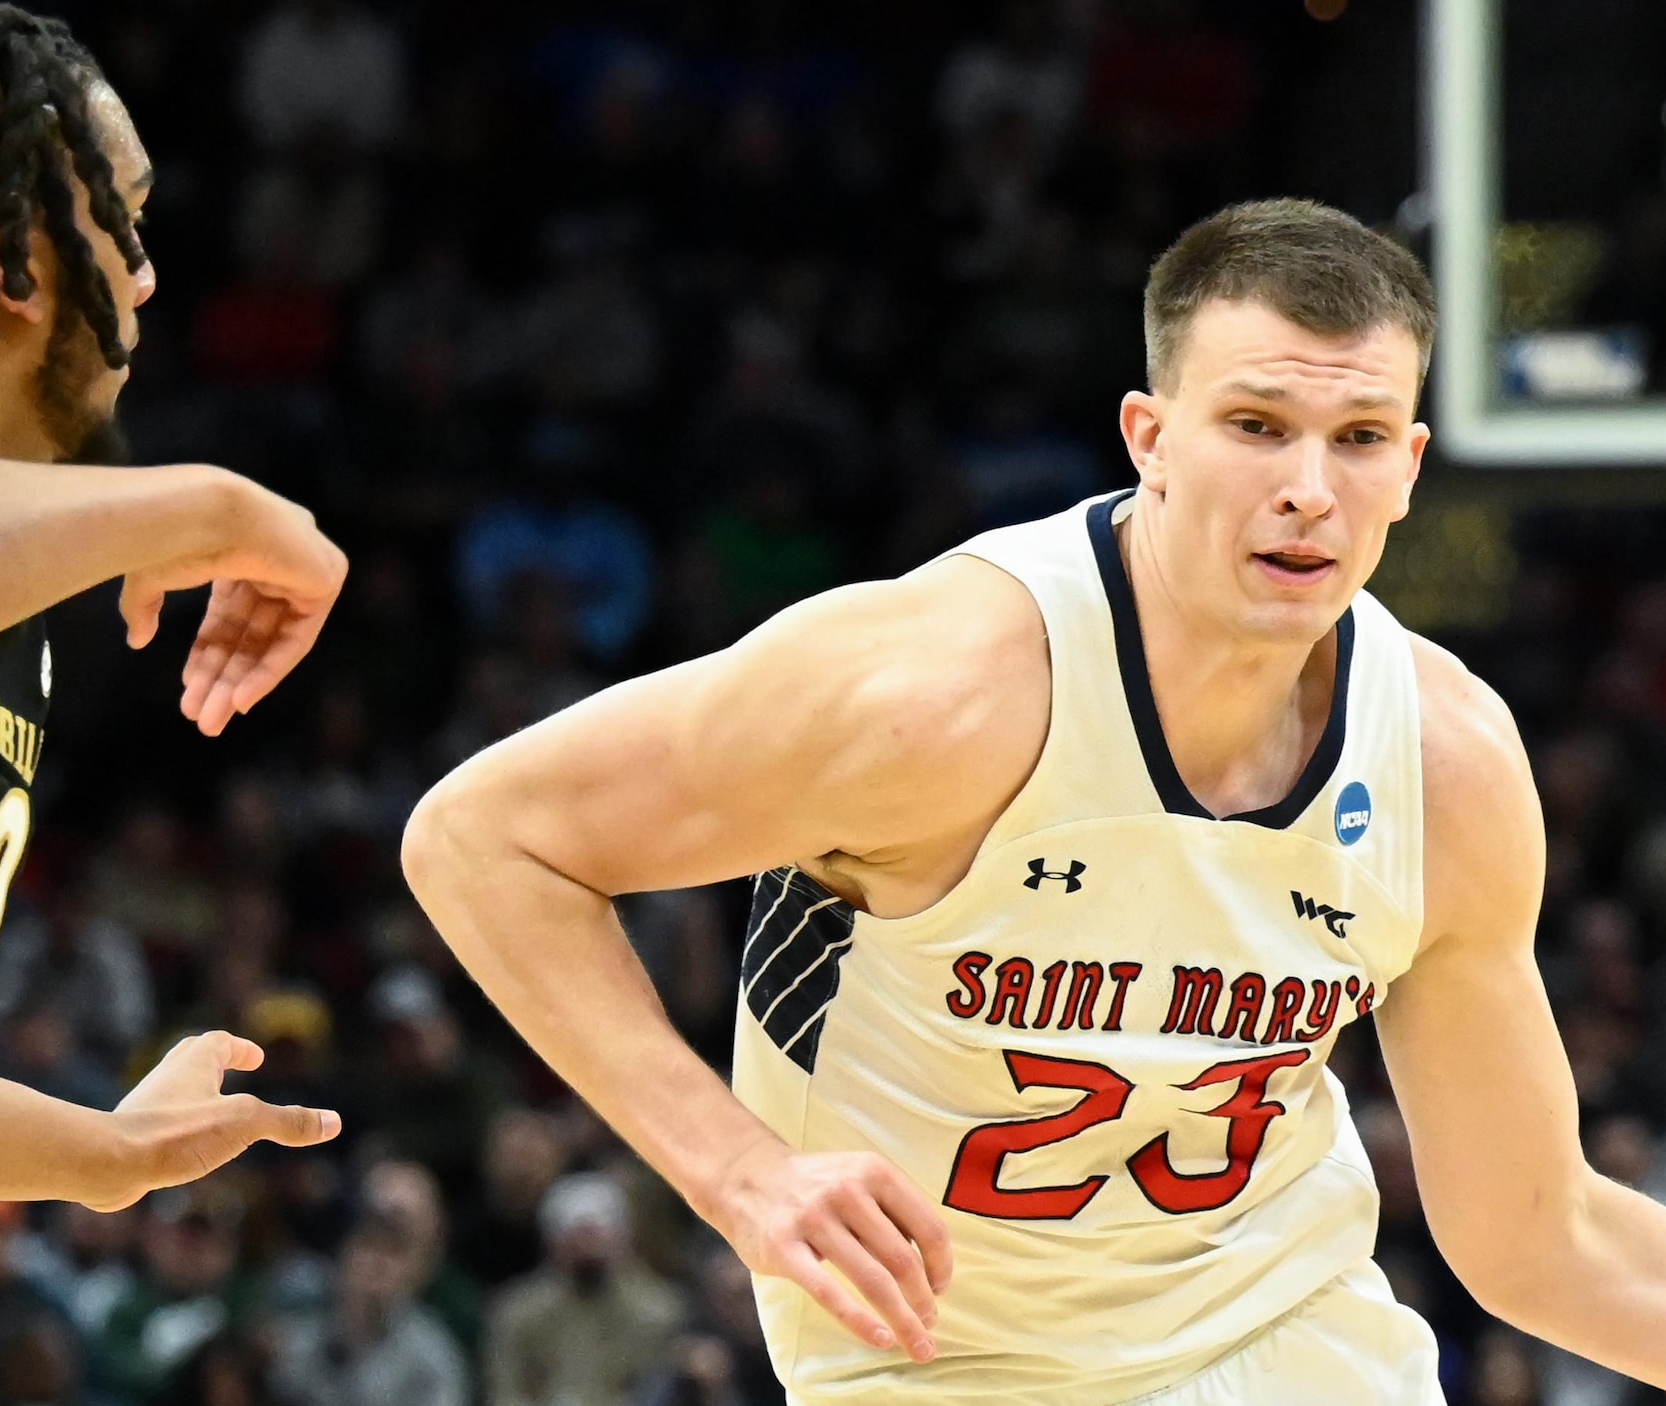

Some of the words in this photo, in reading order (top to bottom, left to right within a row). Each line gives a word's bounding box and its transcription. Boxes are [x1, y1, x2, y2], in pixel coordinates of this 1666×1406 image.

[1339, 810, 1369, 830] NCAA
[946, 951, 1142, 1031] SAINT
[942, 1048, 1311, 1219] 23
